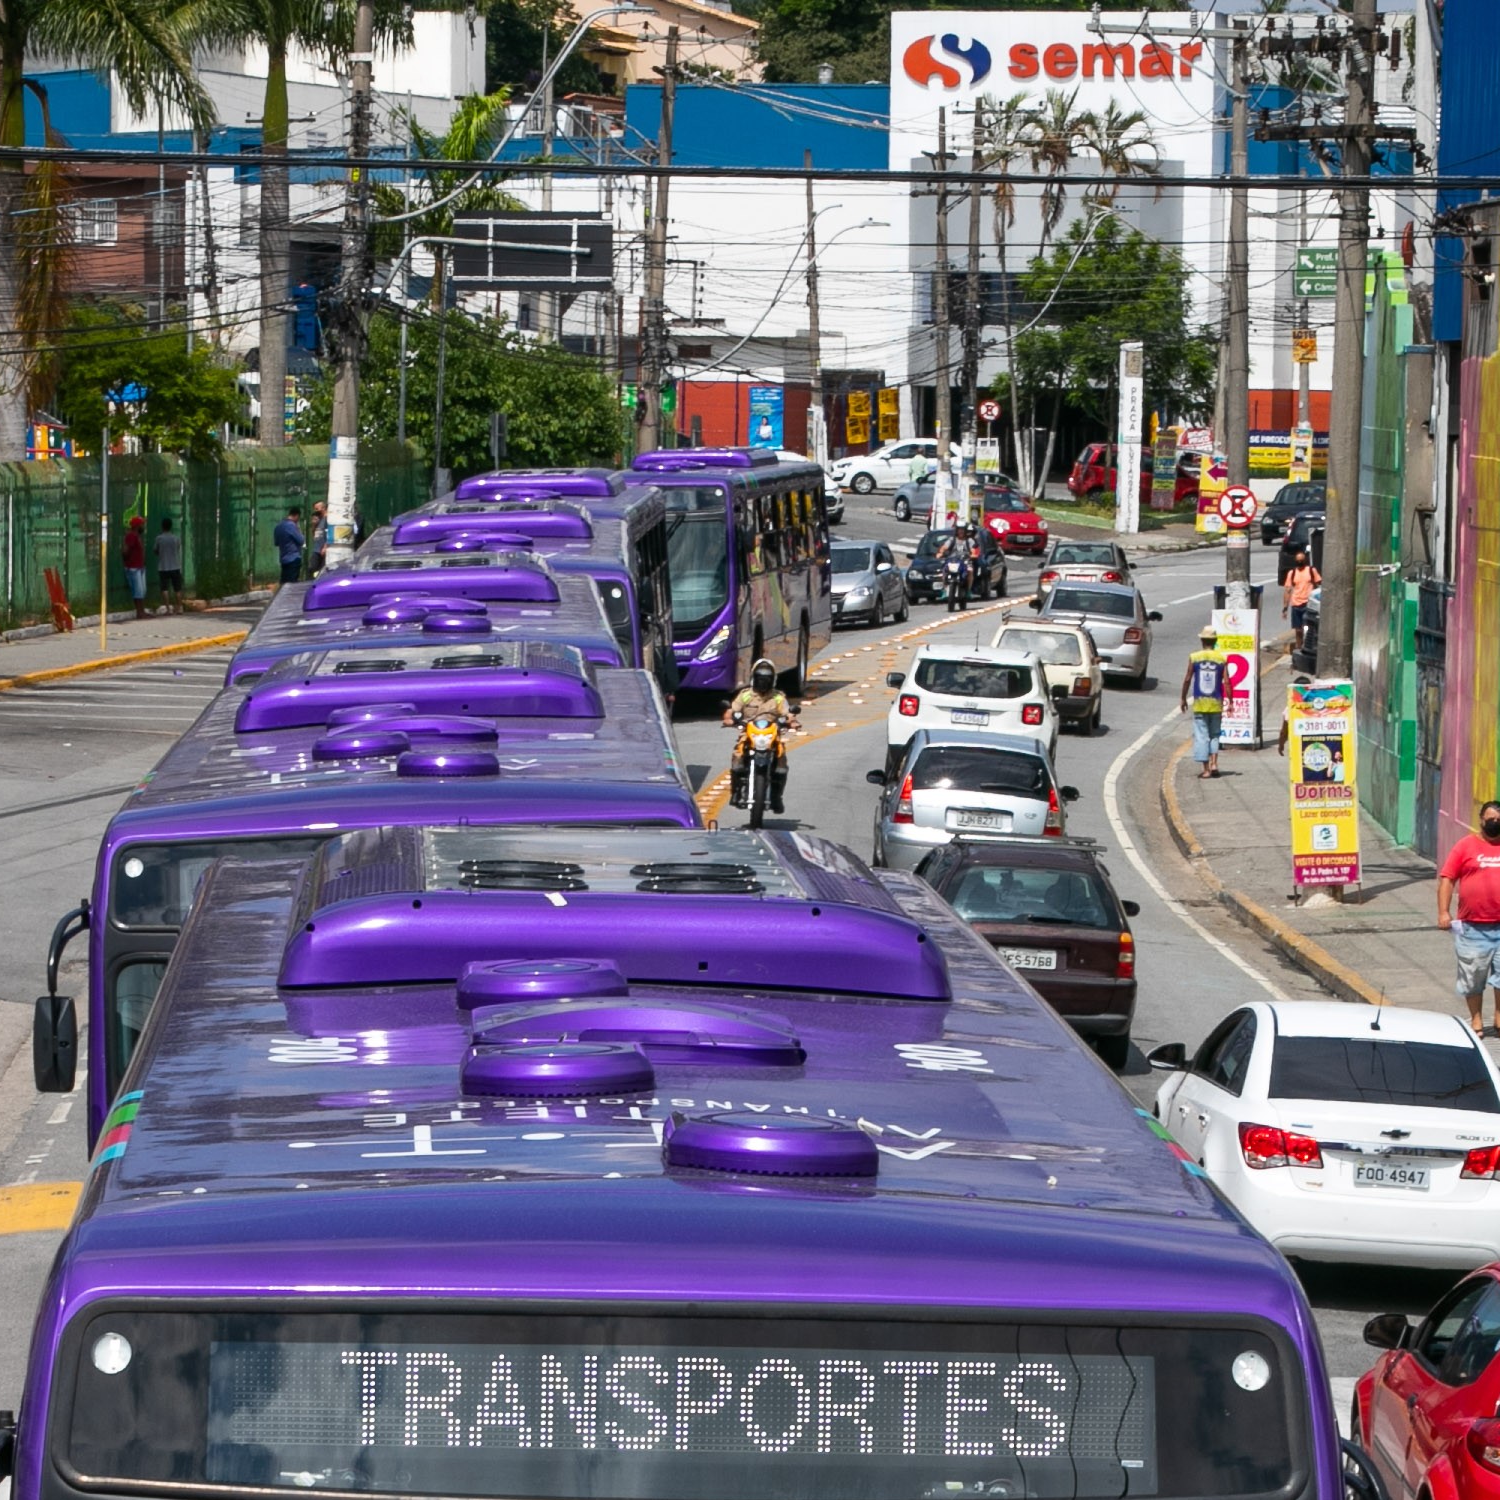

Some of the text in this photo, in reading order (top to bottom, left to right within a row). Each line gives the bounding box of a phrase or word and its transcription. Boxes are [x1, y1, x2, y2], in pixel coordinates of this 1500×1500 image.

[1008, 42, 1204, 79] semar
[1222, 654, 1250, 699] 2
[1295, 784, 1353, 801] Dorms
[341, 1351, 1066, 1457] TRANSPORTES
